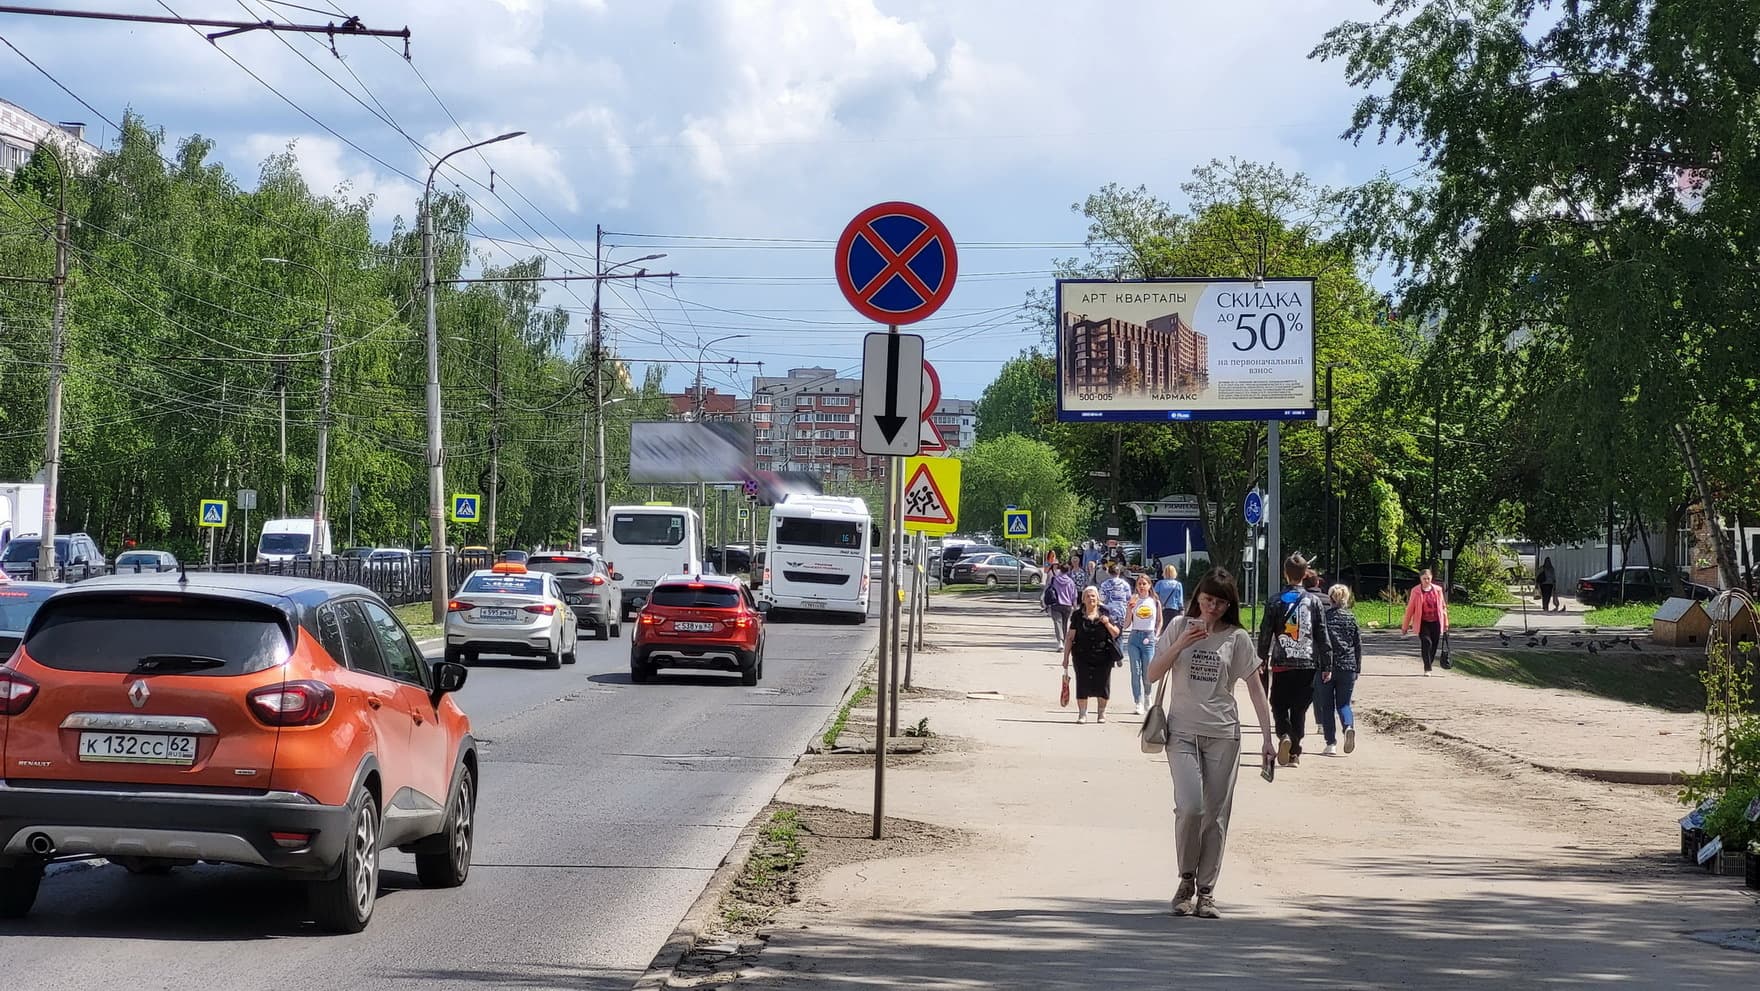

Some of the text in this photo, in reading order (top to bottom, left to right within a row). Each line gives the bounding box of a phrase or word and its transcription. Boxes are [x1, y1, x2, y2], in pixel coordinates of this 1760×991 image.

[1081, 293, 1187, 304] АРТ КВАРТАЛЫ
[1216, 292, 1303, 310] СКИДКА
[1232, 312, 1304, 352] 50%
[1217, 356, 1304, 368] на первоначальный
[1249, 367, 1273, 375] взнос
[1079, 393, 1113, 401] 500-005
[1151, 393, 1198, 401] МАРМАКС
[169, 737, 190, 752] 62
